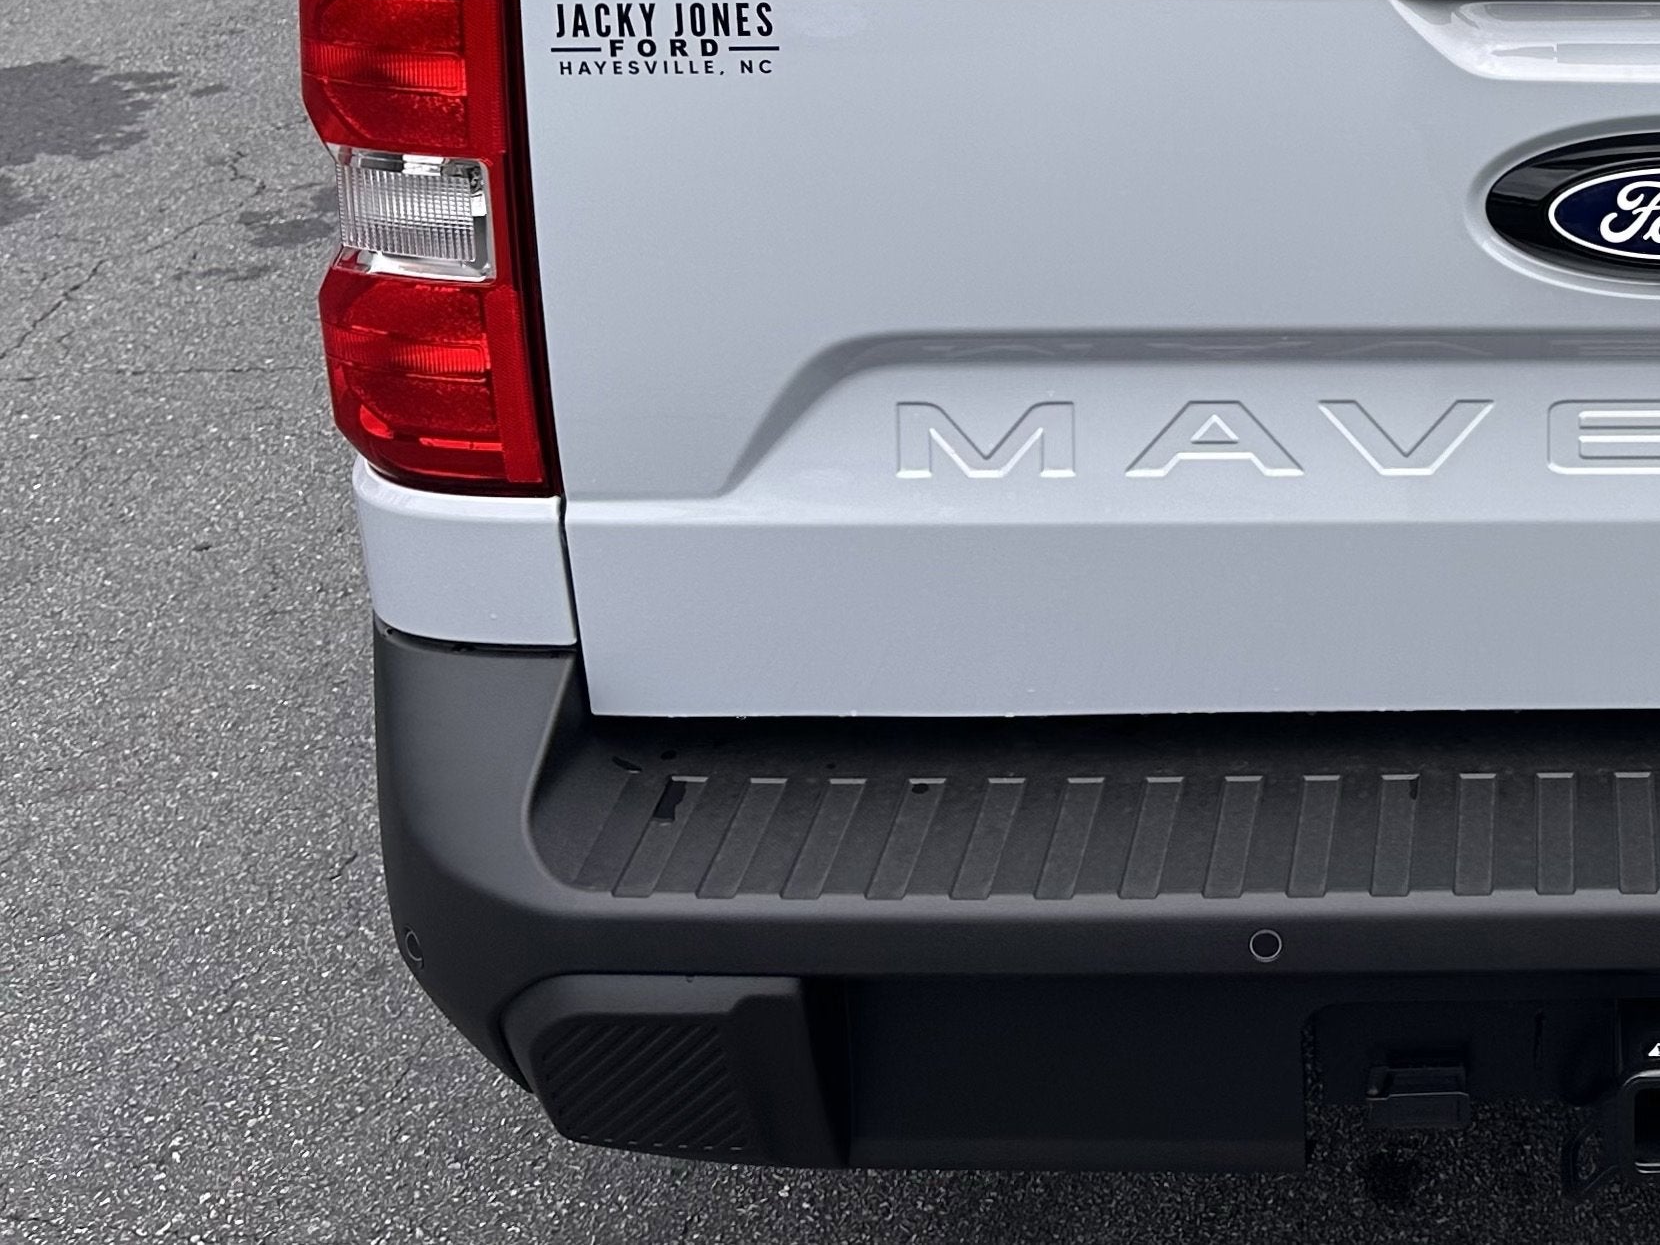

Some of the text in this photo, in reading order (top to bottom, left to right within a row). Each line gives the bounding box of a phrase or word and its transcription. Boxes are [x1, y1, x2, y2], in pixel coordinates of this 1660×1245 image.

[556, 2, 773, 38] JACKY JONES
[609, 39, 719, 57] FORD
[559, 59, 773, 76] HAYESVILLE, NC
